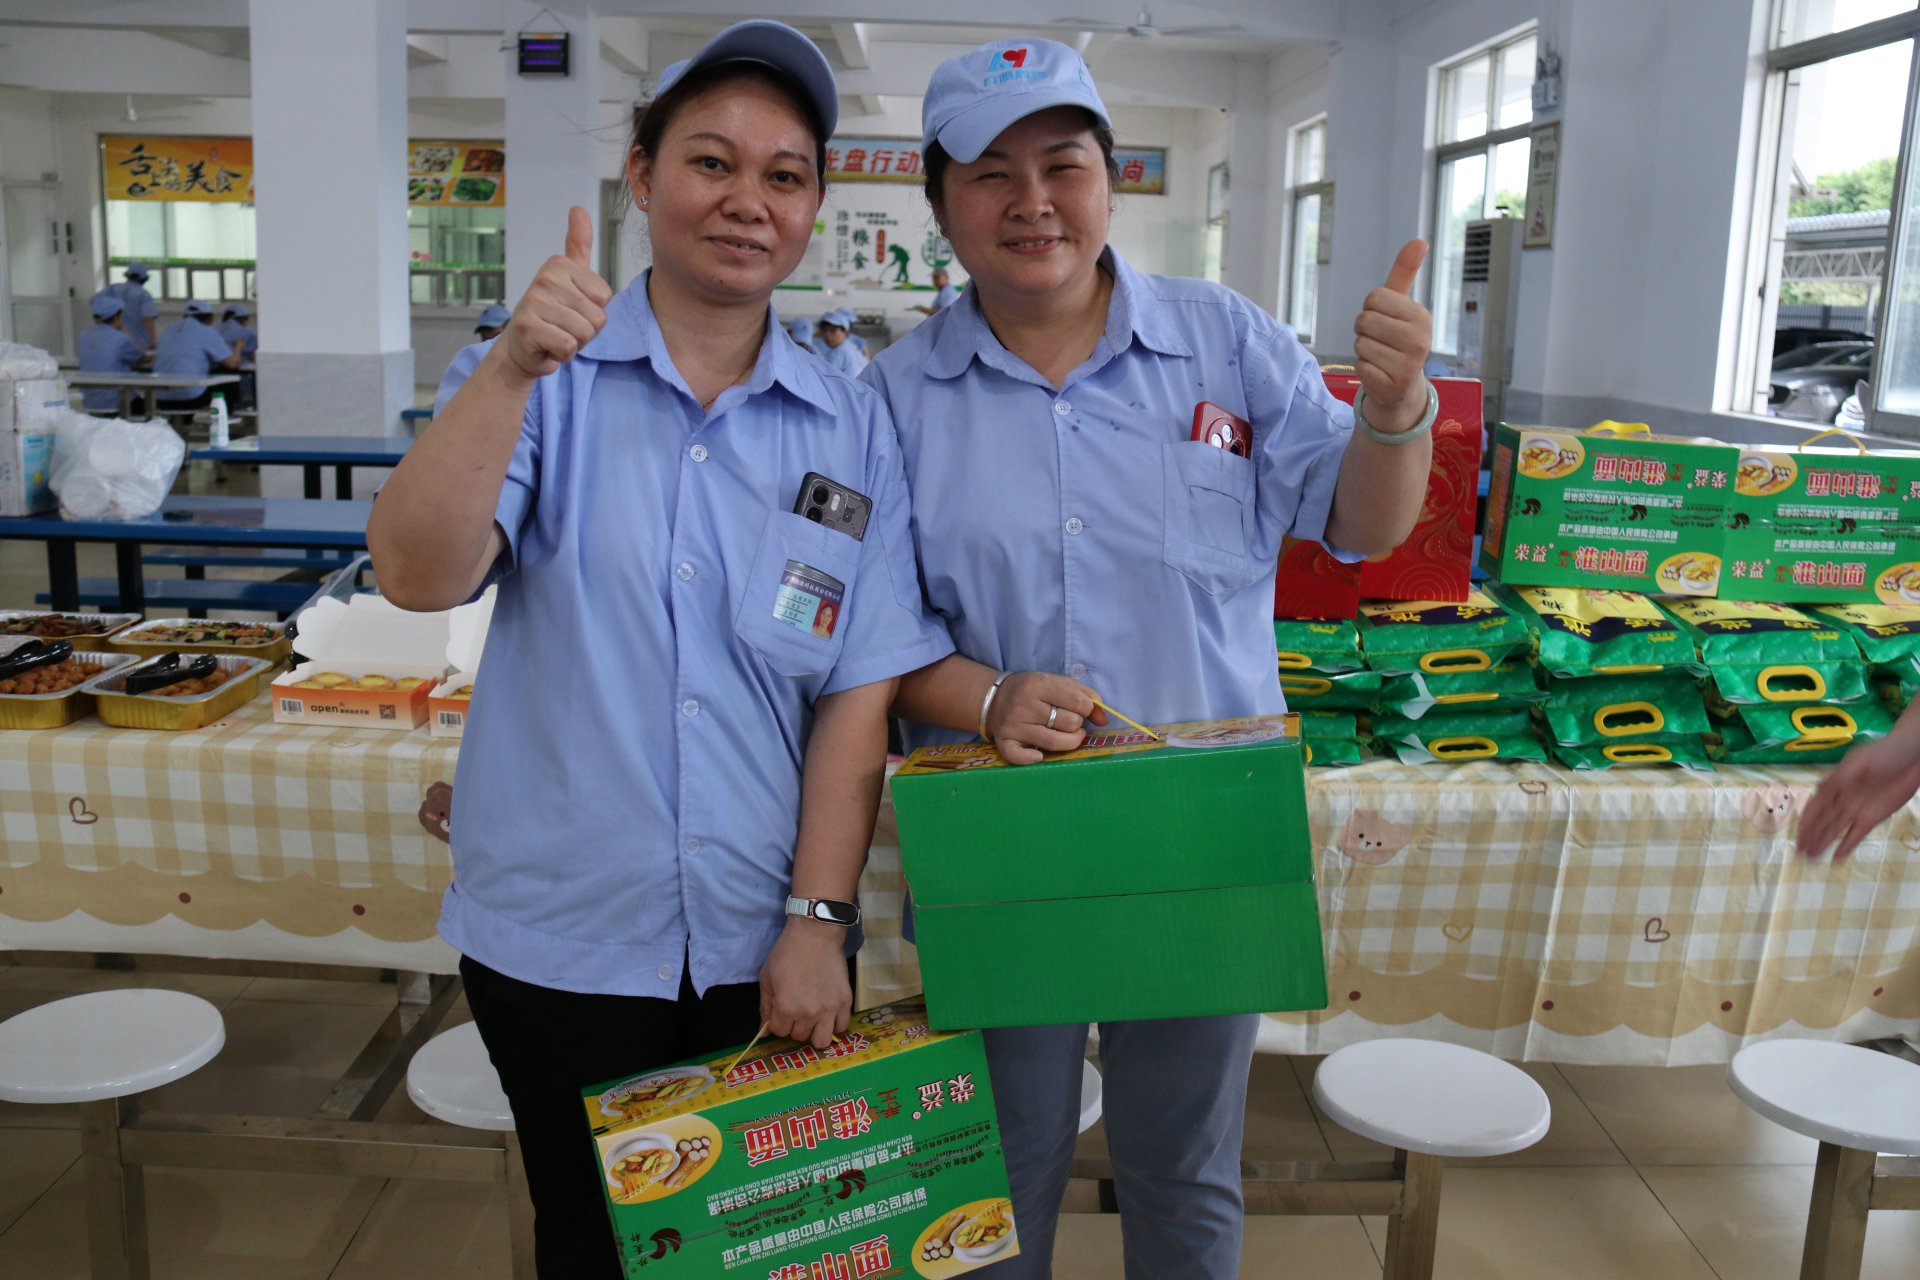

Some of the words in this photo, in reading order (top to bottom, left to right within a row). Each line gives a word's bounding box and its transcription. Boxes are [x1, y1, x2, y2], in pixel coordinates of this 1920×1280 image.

[310, 705, 338, 714] open
[915, 1072, 976, 1112] 荣益
[744, 1096, 873, 1168] 淮山面
[721, 1187, 928, 1263] 本产品质量由中国人民保险公司承保
